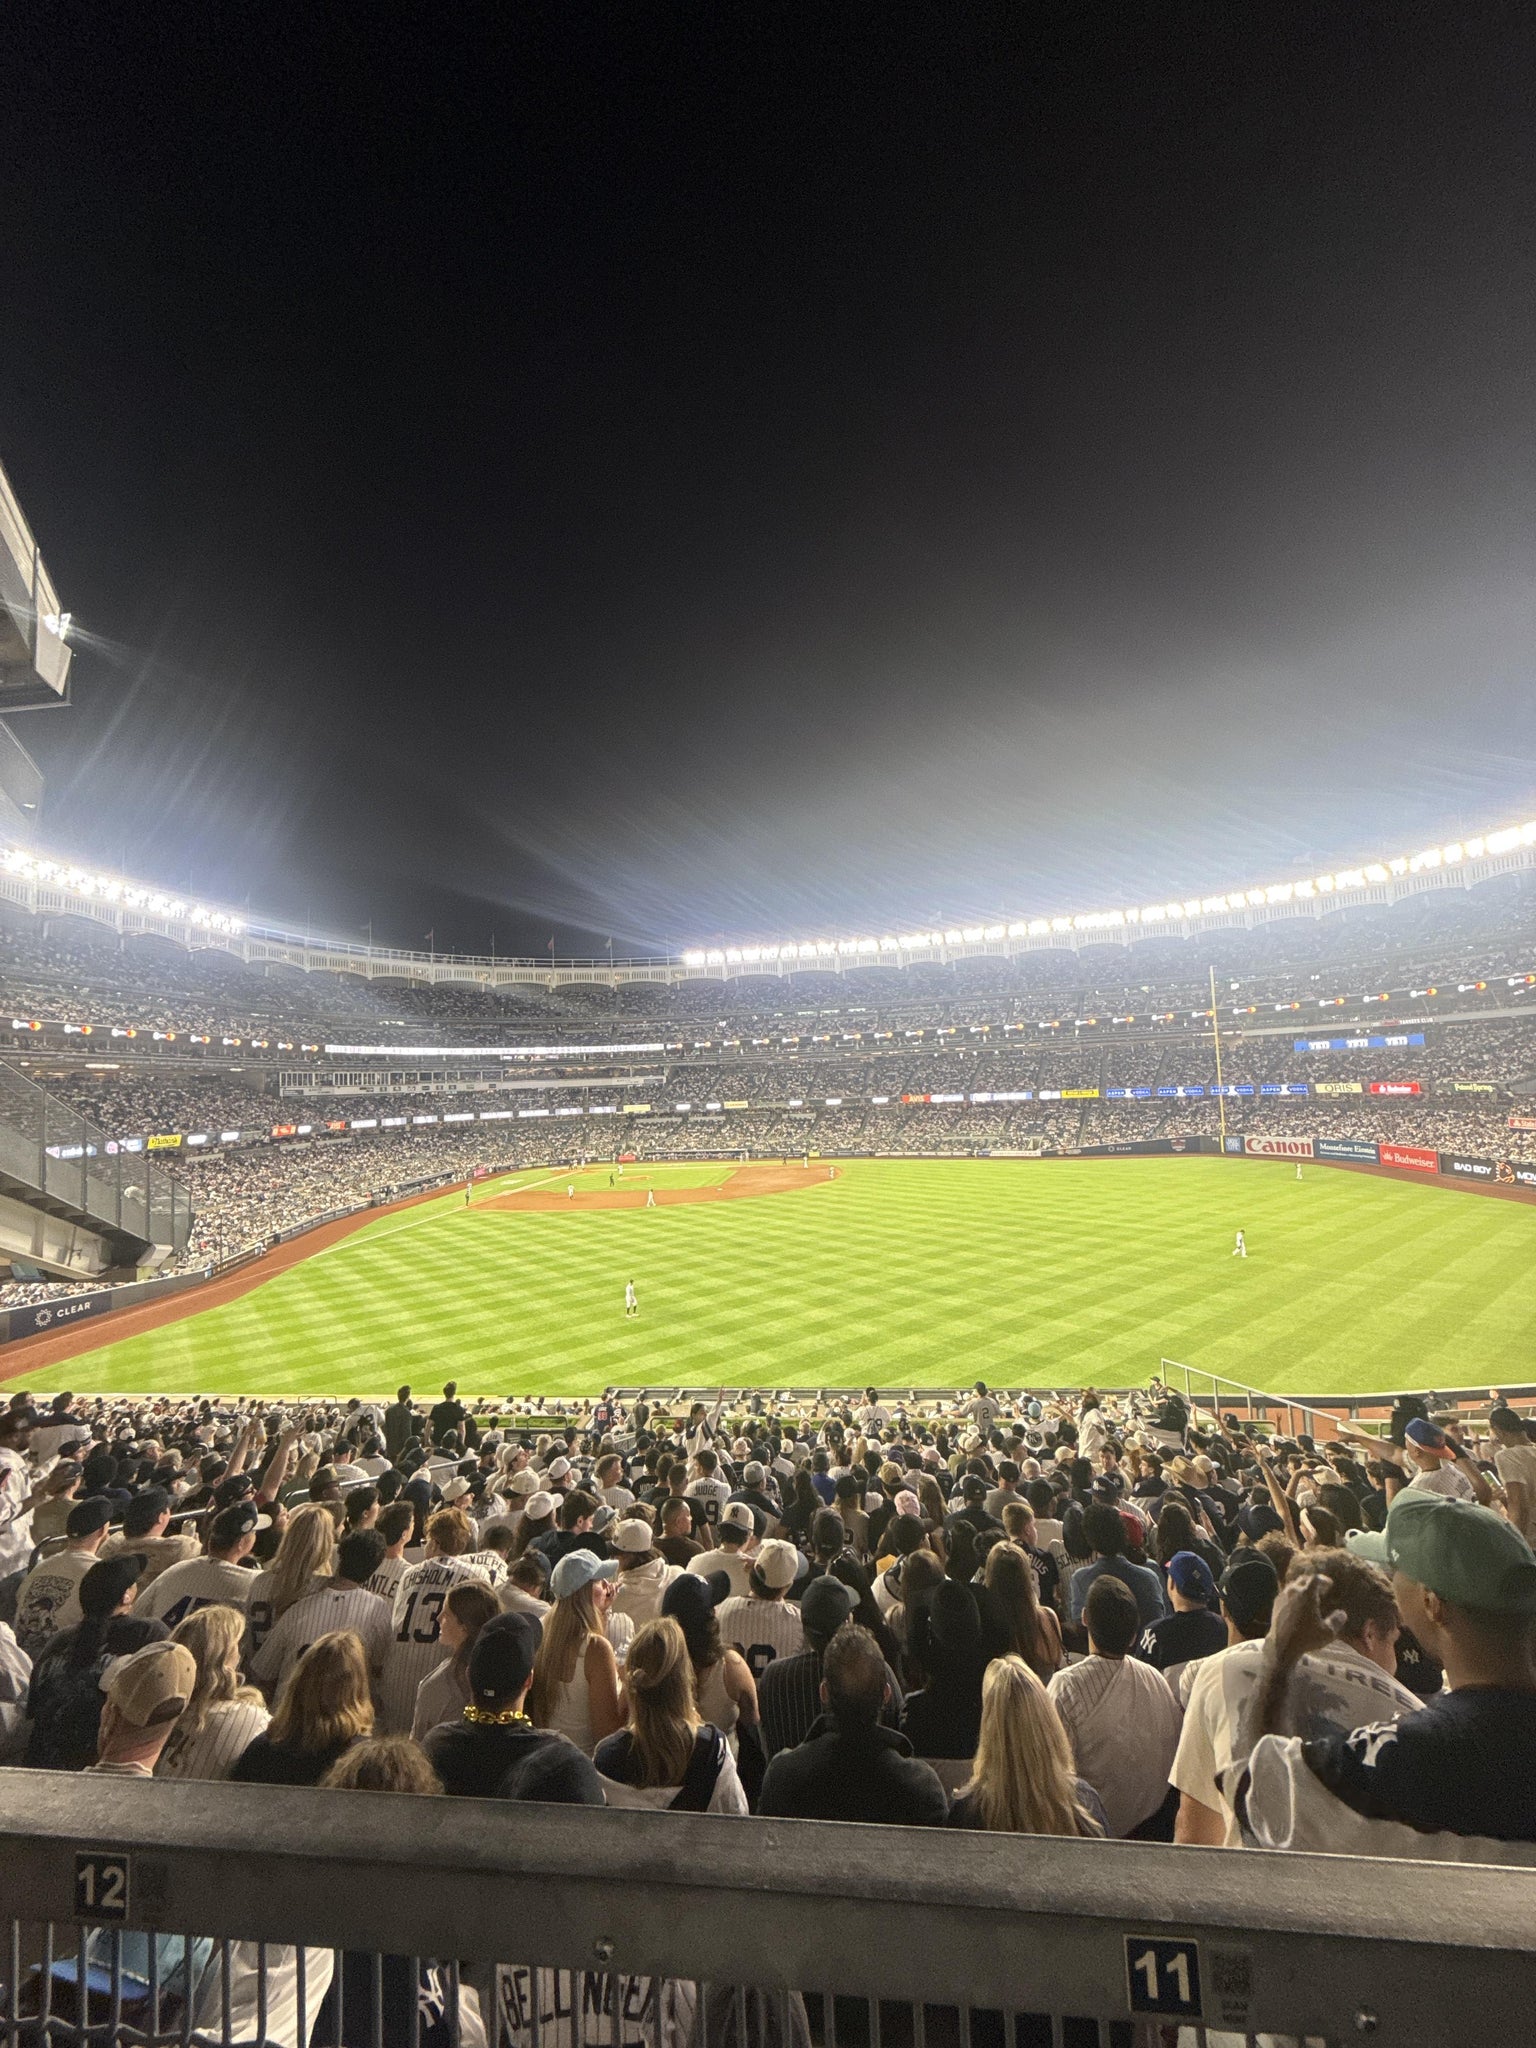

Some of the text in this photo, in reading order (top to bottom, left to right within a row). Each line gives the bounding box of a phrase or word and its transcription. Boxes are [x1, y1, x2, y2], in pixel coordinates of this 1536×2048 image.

[1324, 1084, 1353, 1092] ORIS
[1246, 1138, 1312, 1155] Canon
[1394, 1152, 1435, 1169] Budweiser
[1453, 1162, 1472, 1172] BAD
[1472, 1164, 1492, 1175] BOY
[56, 1301, 91, 1318] CLEAR
[982, 1407, 989, 1419] 2
[694, 1484, 718, 1497] JUDGE
[470, 1555, 506, 1572] VOLPE
[362, 1574, 400, 1599] ANTLE
[396, 1592, 446, 1644] 13
[1140, 1628, 1157, 1655] NY
[1403, 1649, 1420, 1664] NY
[79, 1864, 125, 1908] 12
[1135, 1950, 1190, 2002] 11
